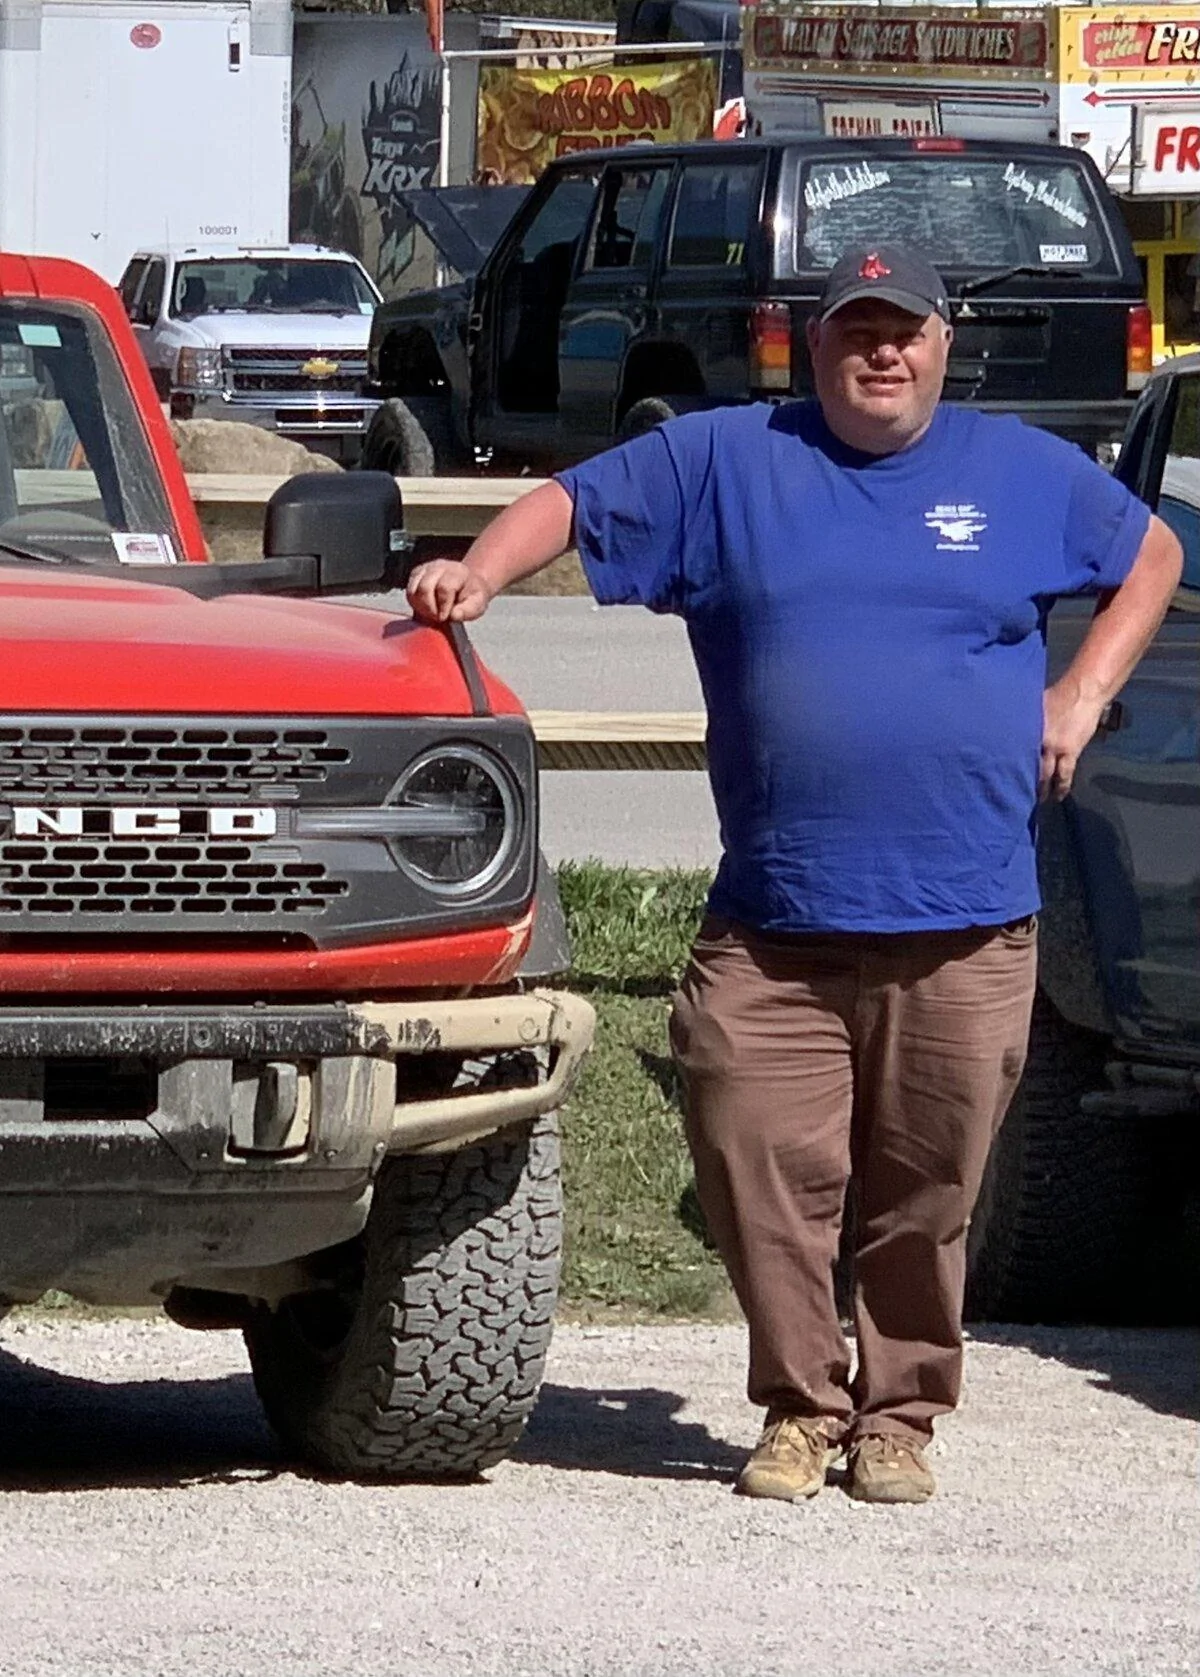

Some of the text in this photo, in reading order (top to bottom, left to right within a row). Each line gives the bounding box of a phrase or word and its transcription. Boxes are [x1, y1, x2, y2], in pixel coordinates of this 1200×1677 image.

[839, 20, 911, 56] SAUSAGE
[914, 21, 1016, 59] SANDWICHES
[1145, 22, 1200, 62] FR
[539, 74, 672, 134] RIBBON
[364, 158, 430, 193] KRX
